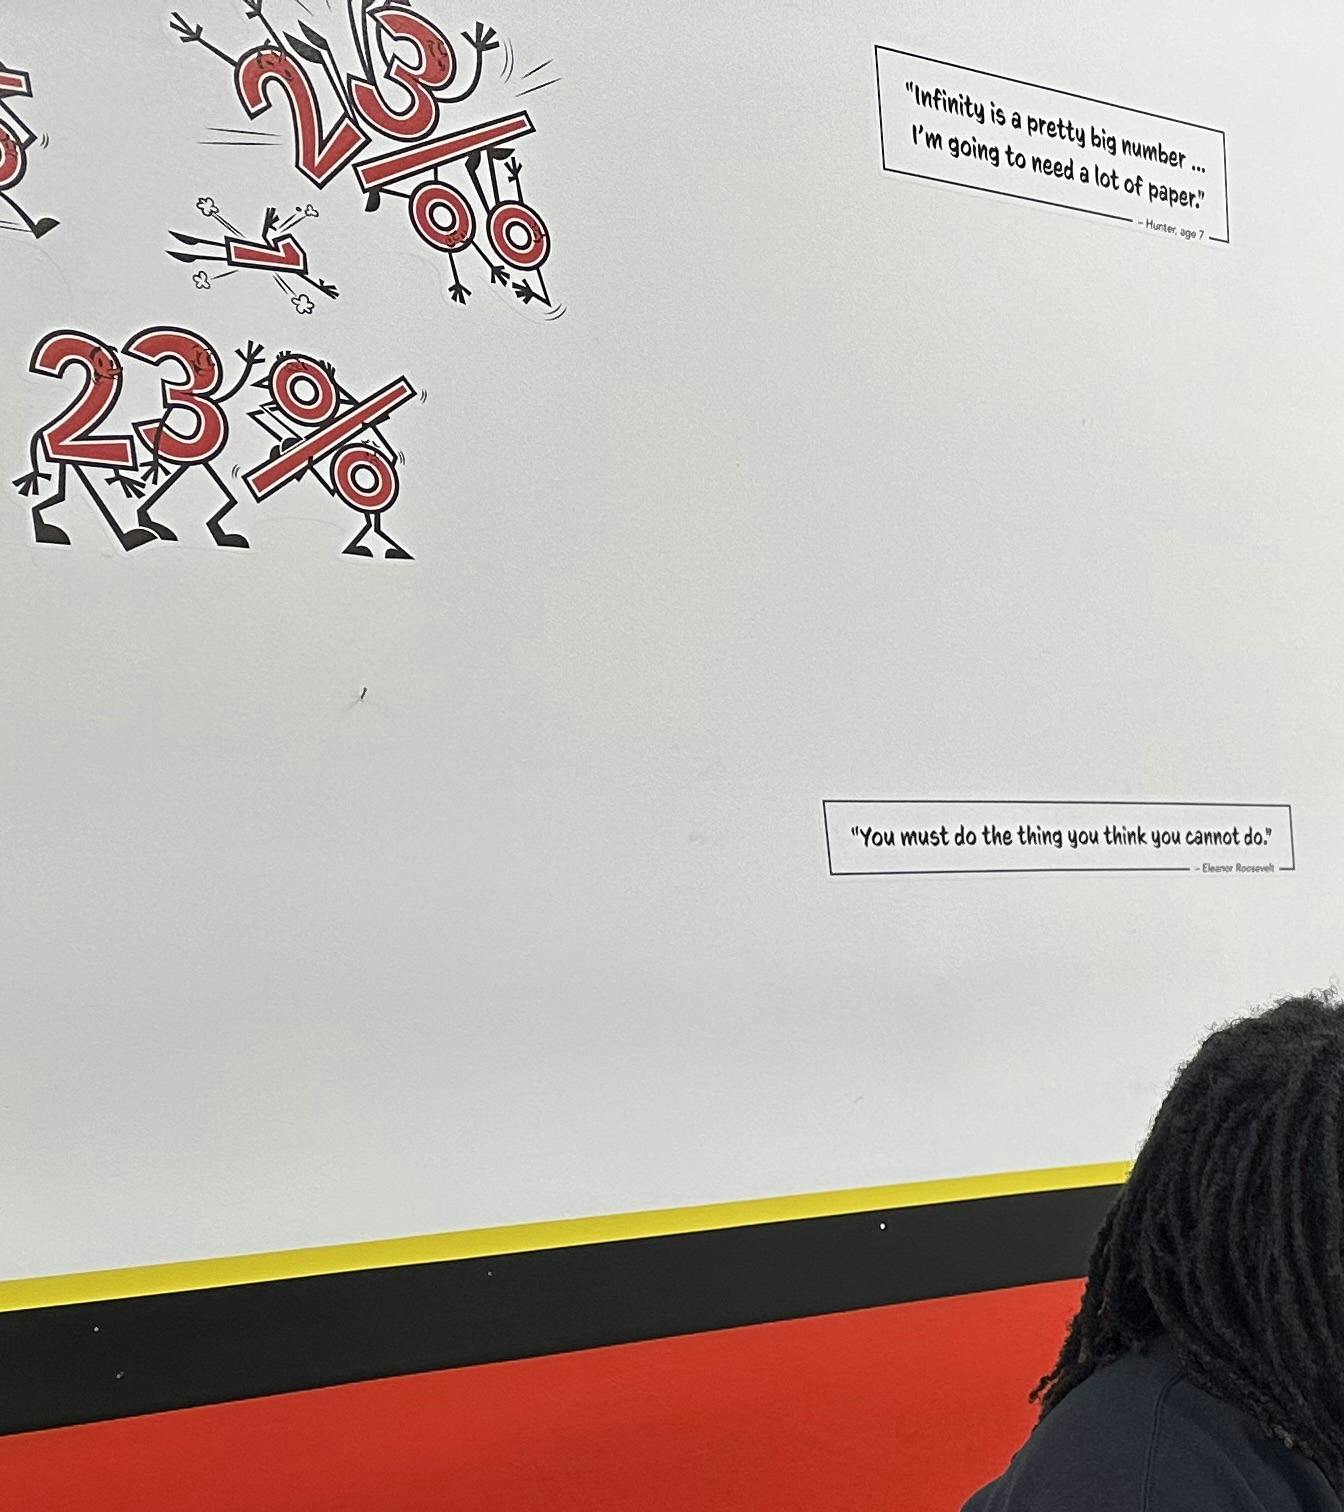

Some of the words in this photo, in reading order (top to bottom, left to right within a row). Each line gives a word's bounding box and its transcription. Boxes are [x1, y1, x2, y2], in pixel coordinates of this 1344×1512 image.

[905, 81, 985, 125] "Infinity
[990, 101, 1006, 126] is
[1011, 112, 1022, 129] a
[1027, 114, 1086, 149] pretty
[1090, 125, 1117, 156] big
[1121, 135, 1186, 170] number
[912, 124, 943, 151] I'm
[949, 136, 1000, 167] going
[1005, 145, 1026, 169] to
[1032, 158, 1074, 181] need
[1080, 166, 1089, 183] a
[1095, 164, 1119, 191] lot
[1124, 174, 1143, 197] of
[1148, 182, 1205, 209] paper."
[1145, 218, 1177, 236] Hunter,
[1180, 228, 1197, 240] age
[1199, 229, 1205, 240] 7
[851, 825, 895, 848] "You
[900, 825, 950, 848] must
[954, 823, 977, 846] do
[981, 824, 1013, 846] the
[1016, 824, 1062, 849] thing
[1067, 828, 1099, 849] you
[1103, 825, 1147, 846] think
[1151, 828, 1181, 849] you
[1185, 827, 1240, 846] cannot
[1243, 826, 1273, 847] do."
[1202, 862, 1234, 873] Eleanor
[1235, 862, 1275, 873] Roosevelt
